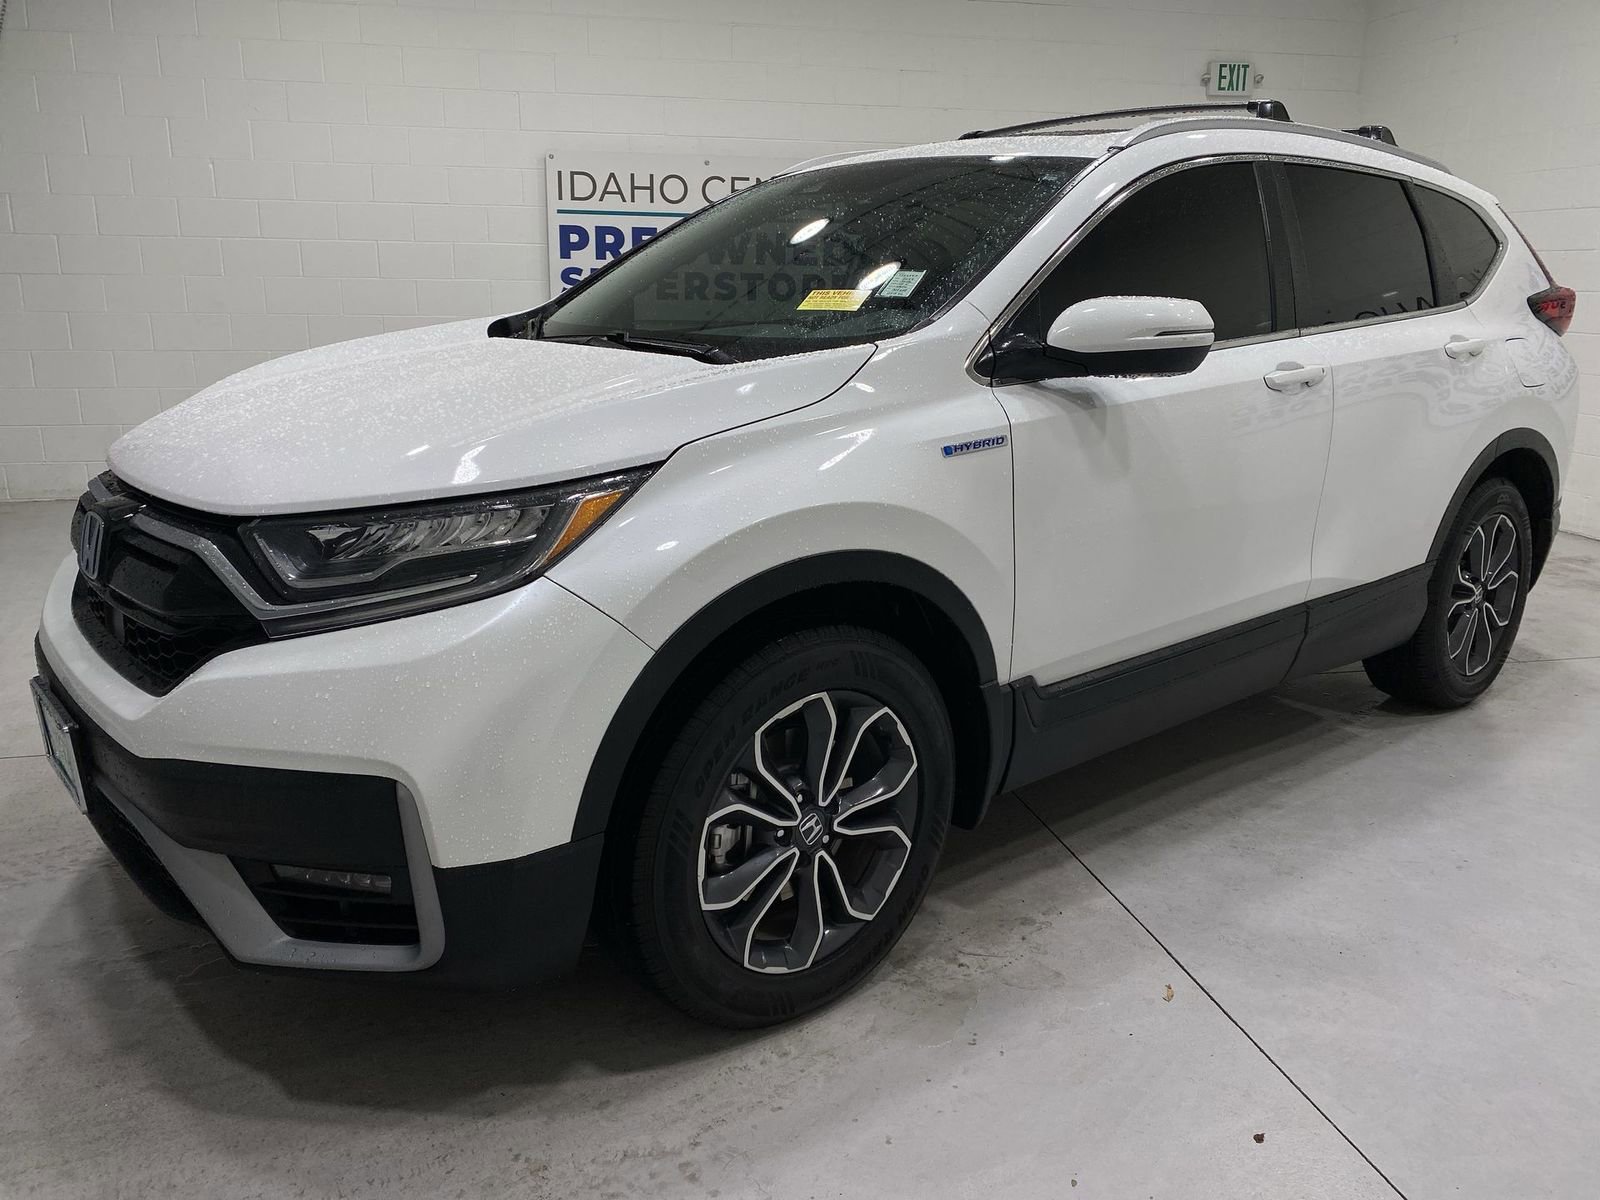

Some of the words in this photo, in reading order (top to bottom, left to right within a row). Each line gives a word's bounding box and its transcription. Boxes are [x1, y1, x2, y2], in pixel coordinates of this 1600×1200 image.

[1217, 63, 1250, 92] EXIT
[557, 170, 689, 205] IDAHO
[702, 175, 763, 205] CE
[953, 436, 1005, 453] HYBRID
